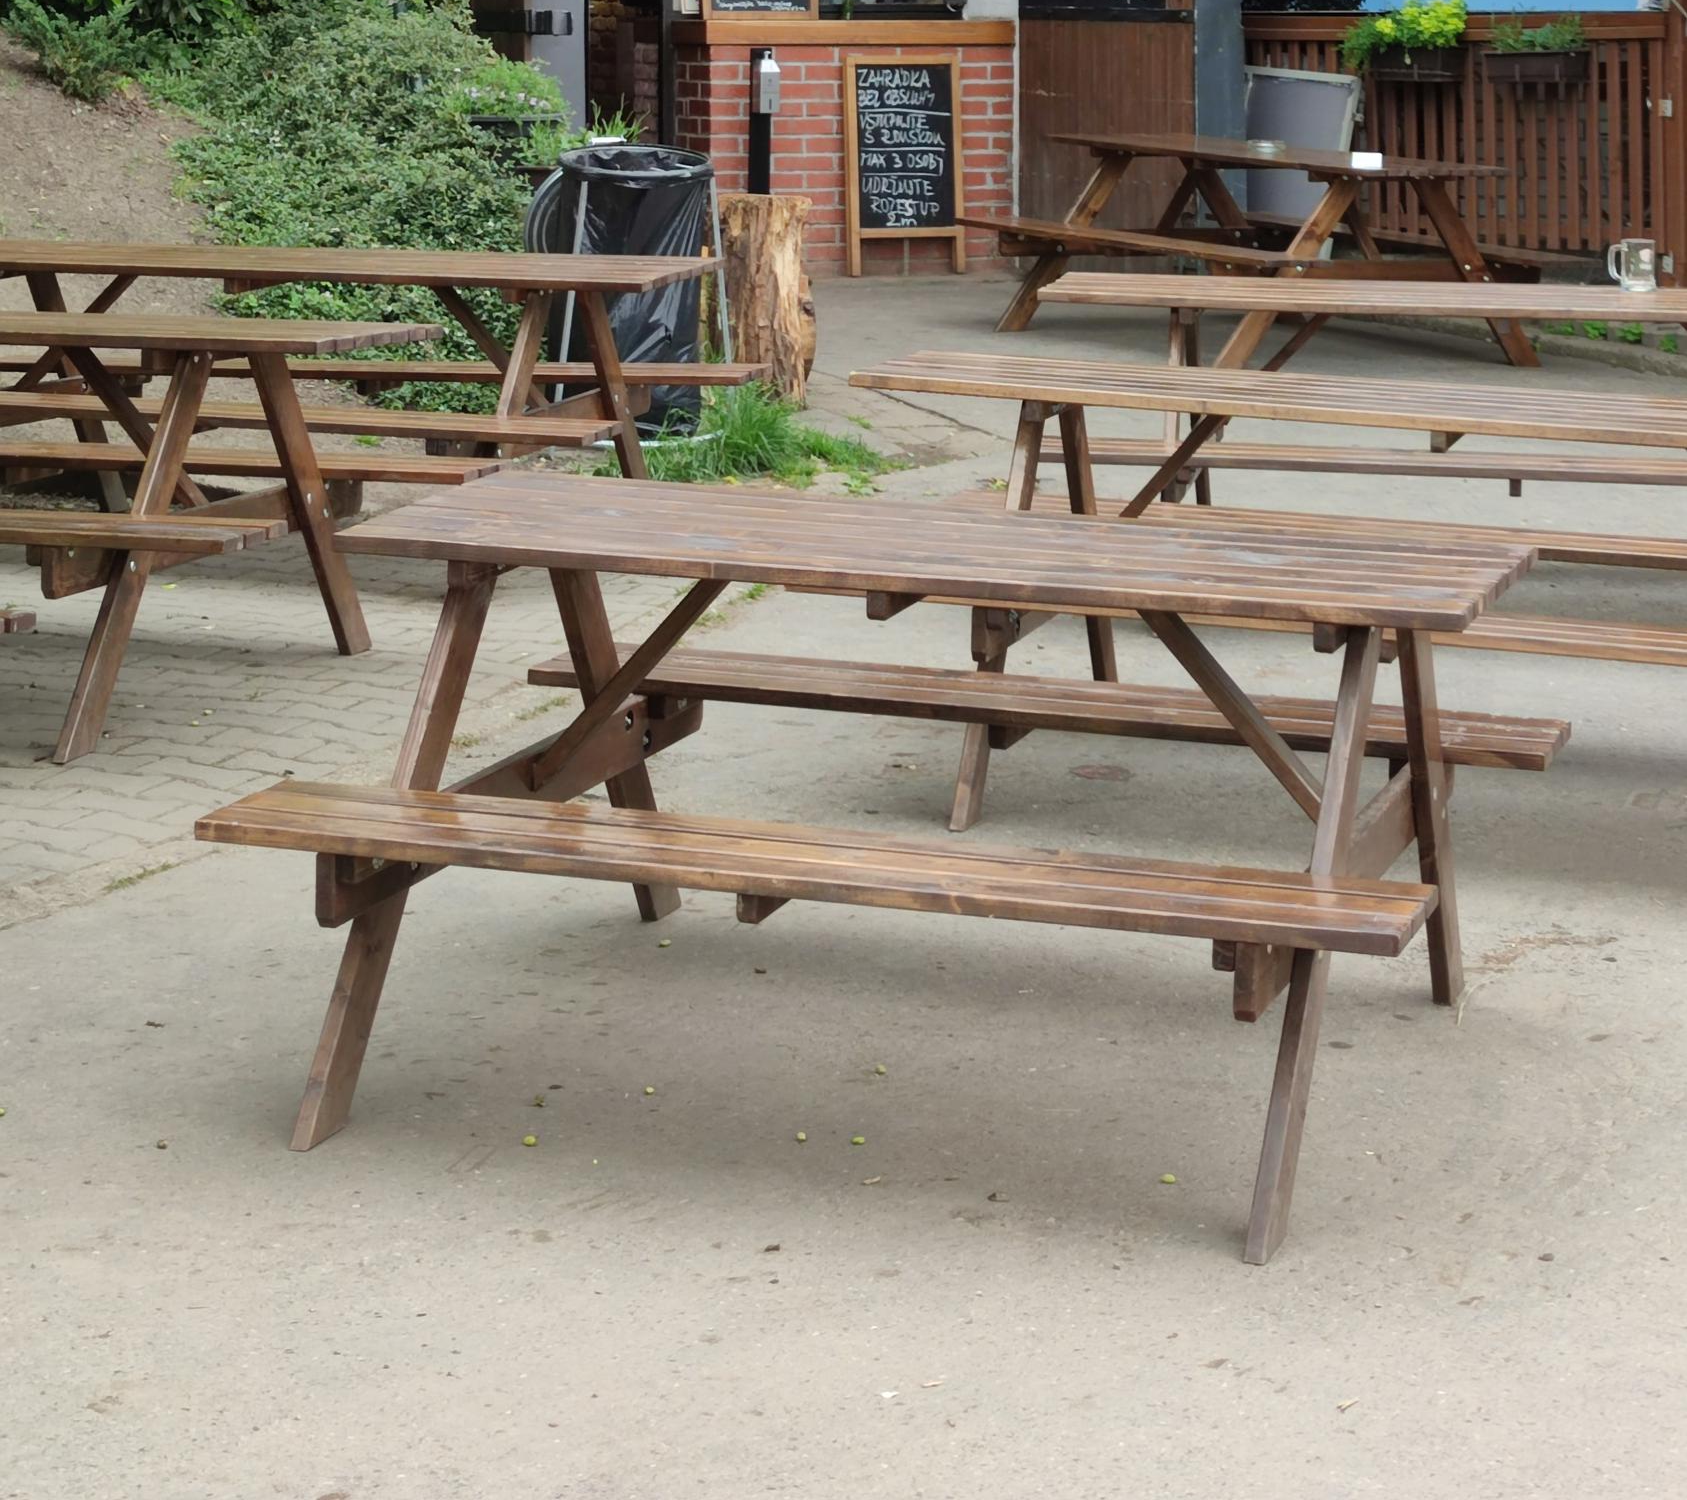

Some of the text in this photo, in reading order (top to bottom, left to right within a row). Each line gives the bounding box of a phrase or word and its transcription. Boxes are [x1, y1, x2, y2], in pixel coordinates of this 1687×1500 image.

[858, 88, 935, 107] BEZ OBSLUHY
[864, 130, 875, 144] S
[860, 153, 944, 177] MAX 3 OSOBY
[862, 176, 935, 196] UDRŽUJTE
[870, 195, 940, 216] ROZESTUP
